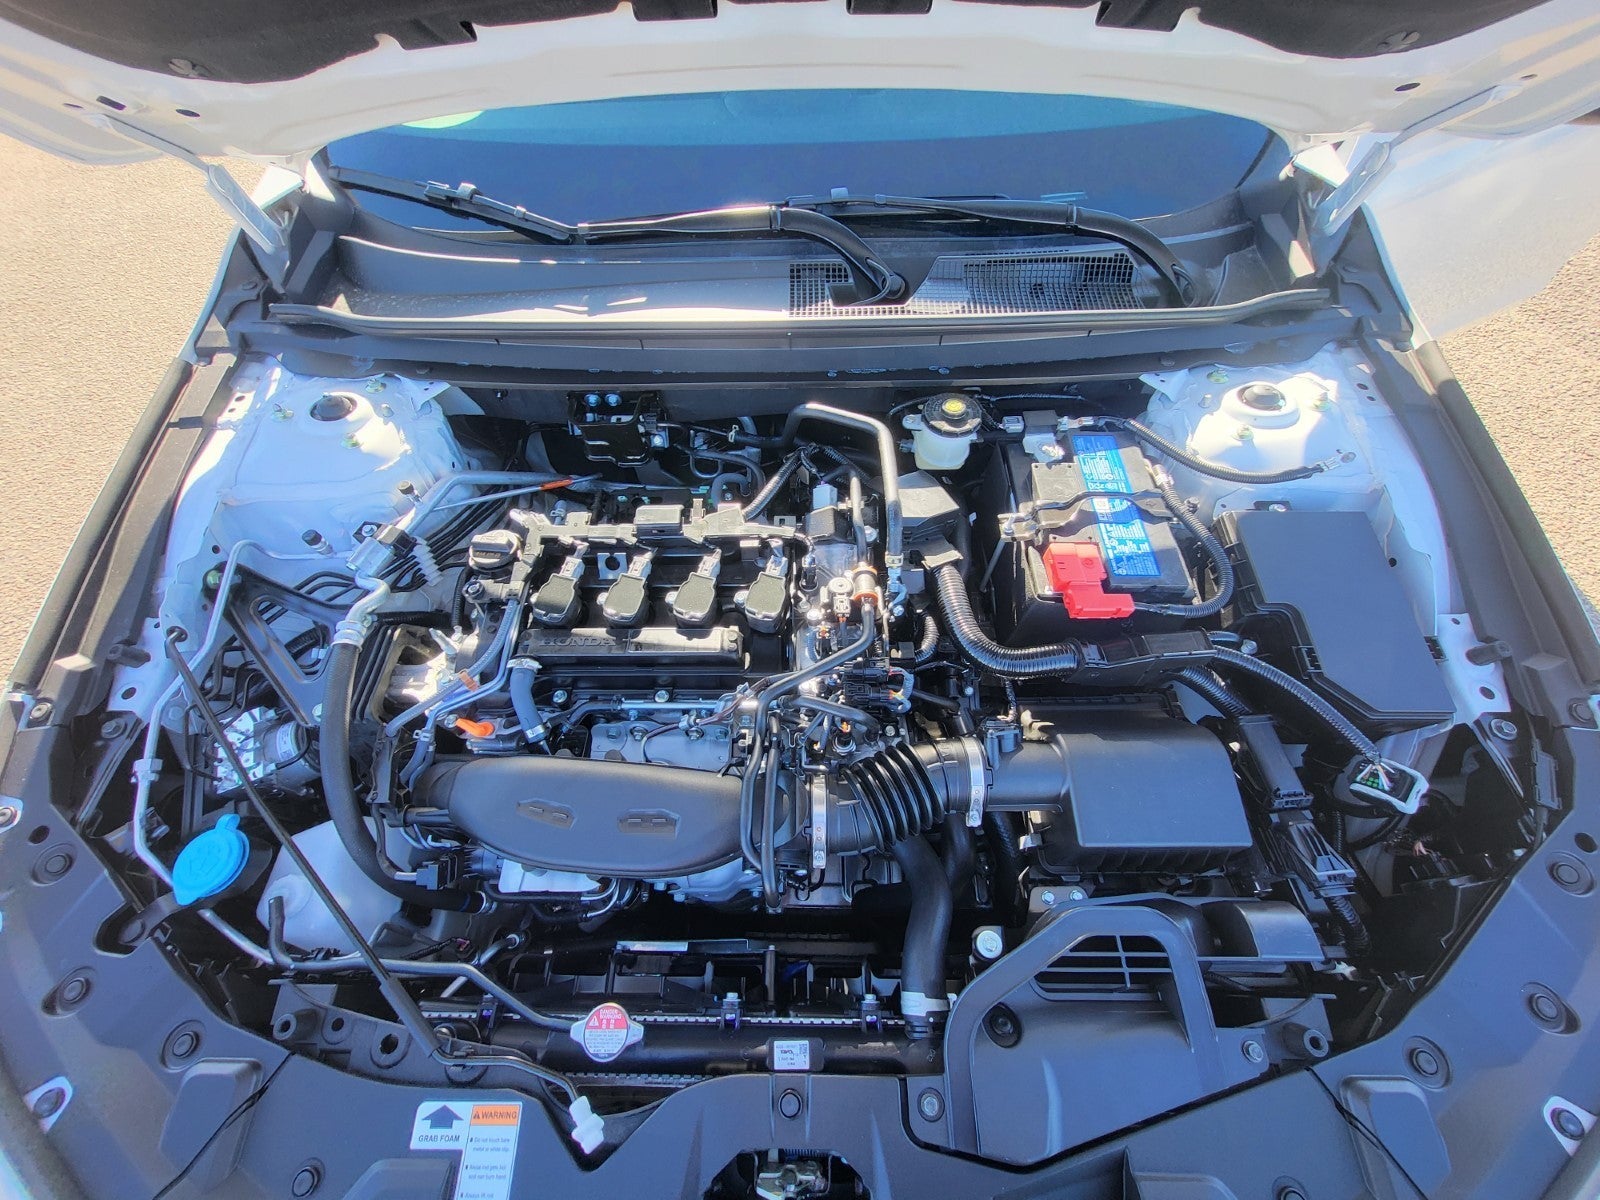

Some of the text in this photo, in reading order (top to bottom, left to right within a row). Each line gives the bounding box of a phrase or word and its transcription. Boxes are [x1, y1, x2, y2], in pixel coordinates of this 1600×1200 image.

[540, 637, 617, 647] HONDA
[481, 1111, 517, 1119] WARNING
[418, 1134, 460, 1142] GRAB FOAM
